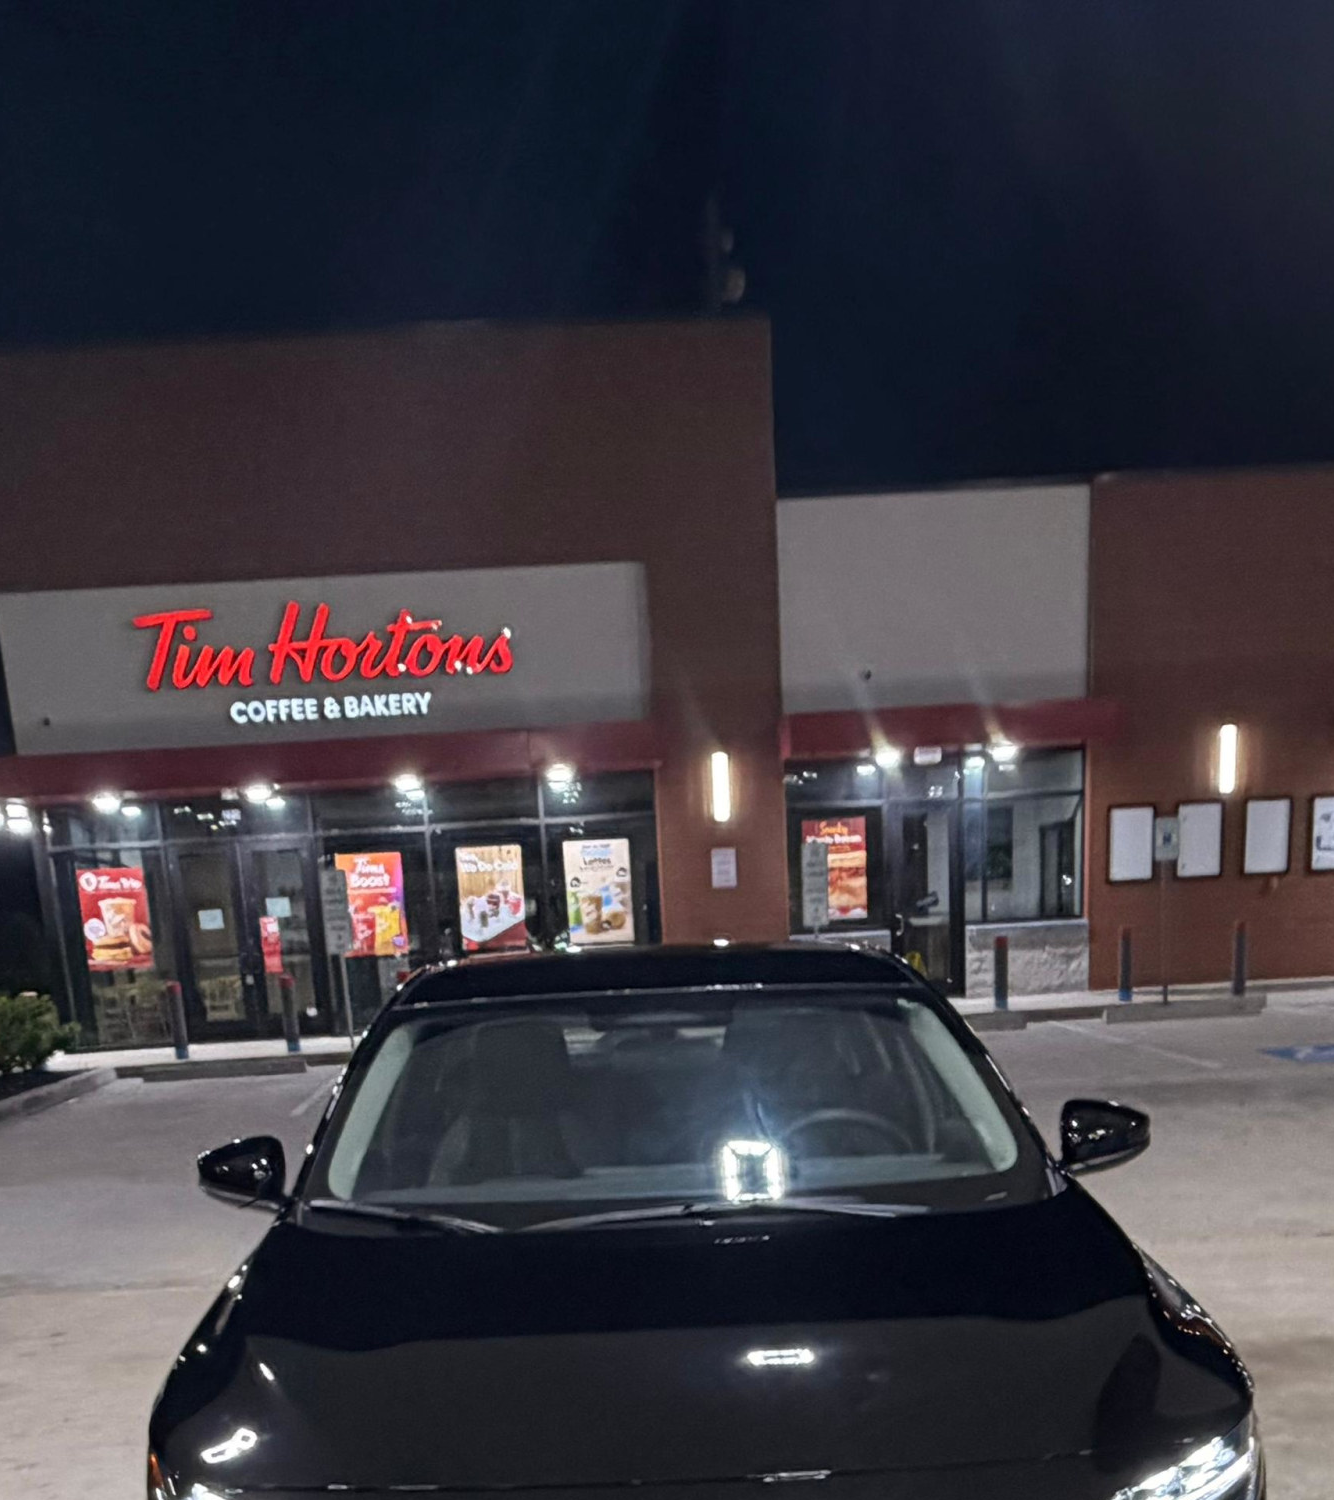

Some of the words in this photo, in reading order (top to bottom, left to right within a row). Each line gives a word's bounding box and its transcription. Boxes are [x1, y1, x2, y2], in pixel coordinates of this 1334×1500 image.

[133, 608, 255, 691] Tim
[268, 600, 514, 683] Hortons
[230, 698, 319, 724] COFFEE
[323, 696, 341, 719] &
[344, 692, 432, 718] BAKERY
